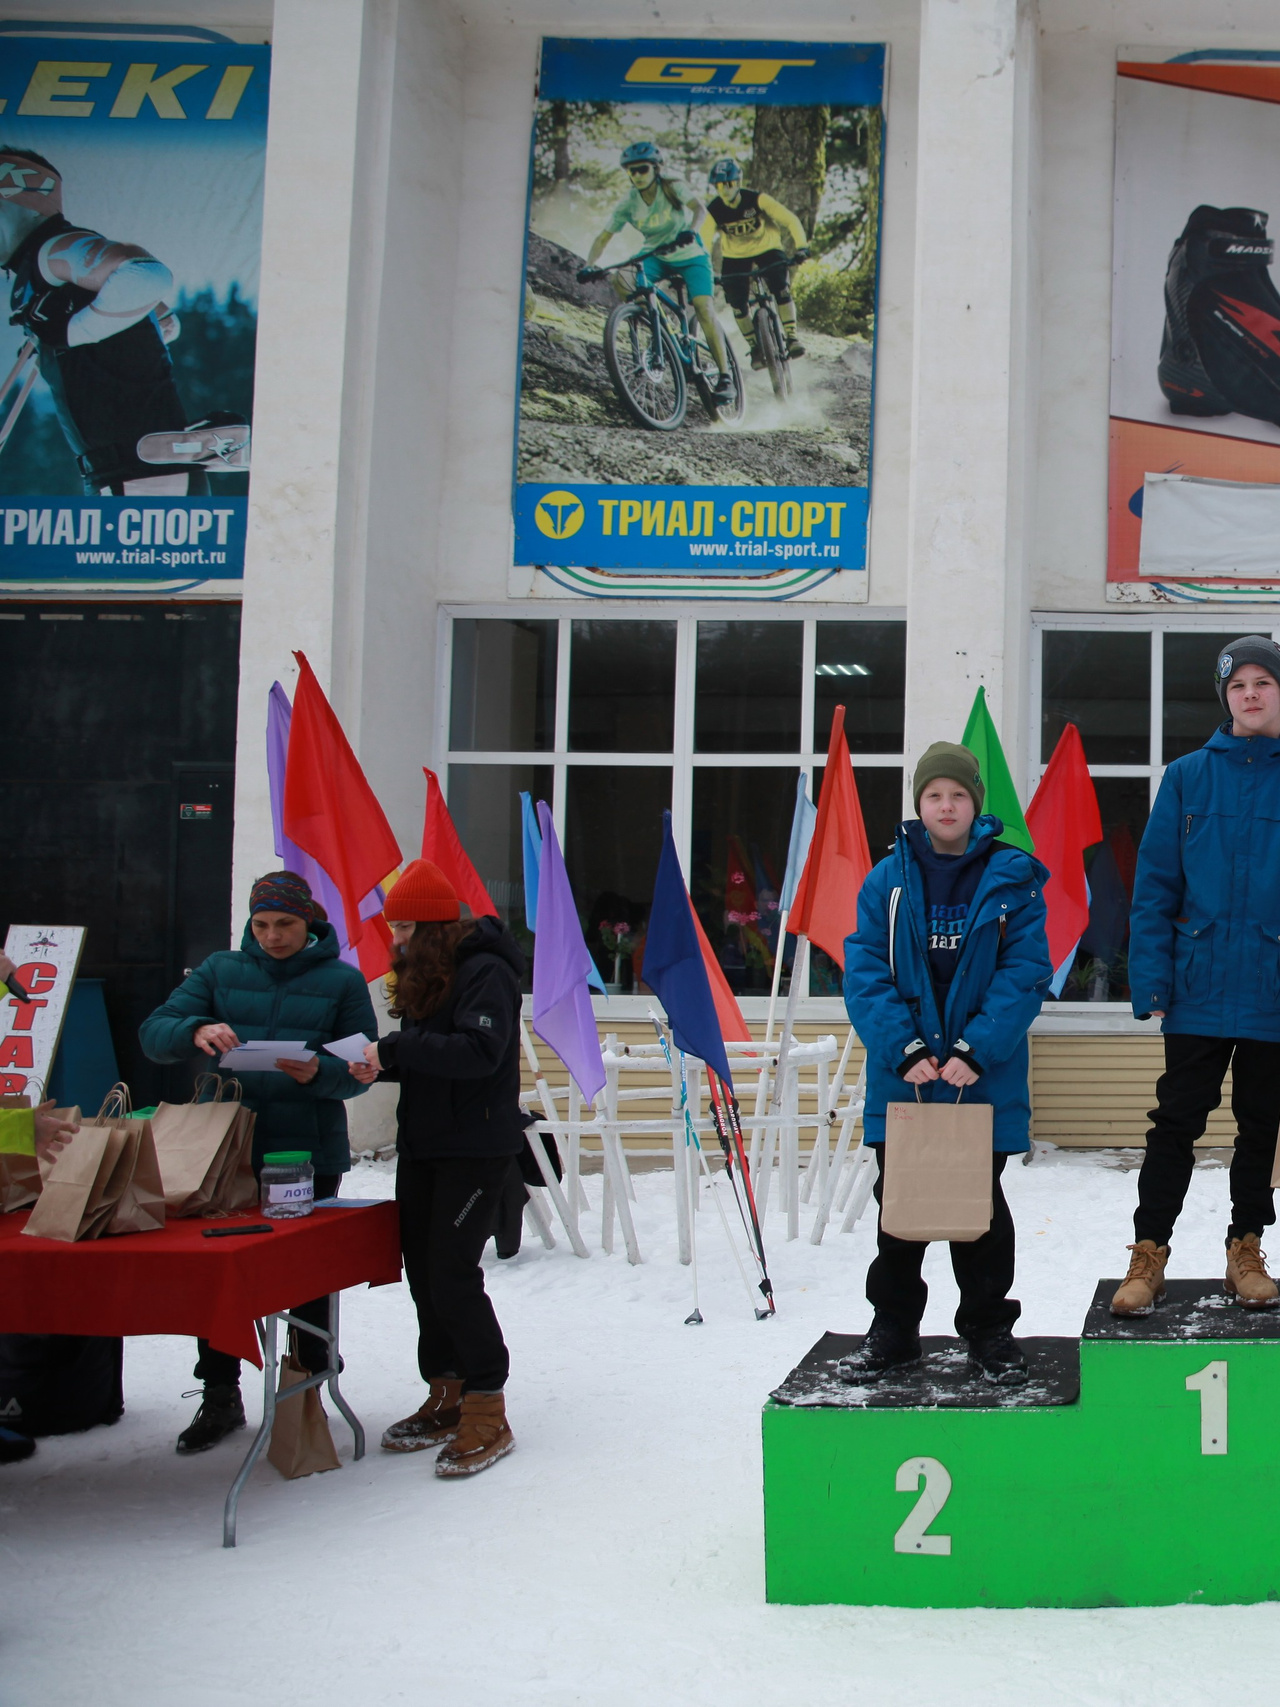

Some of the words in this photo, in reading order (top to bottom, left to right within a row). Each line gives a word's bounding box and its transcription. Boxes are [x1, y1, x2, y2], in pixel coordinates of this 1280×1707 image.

[625, 57, 816, 84] GT
[0, 60, 255, 120] EKI
[690, 86, 768, 95] BICYCLES
[76, 549, 226, 567] www.trial-sport.ru
[689, 541, 840, 560] www.trial-sport.ru
[717, 1105, 728, 1136] NORDWAY
[728, 1104, 740, 1135] NORDWAY
[454, 1188, 483, 1228] noname
[1186, 1360, 1228, 1455] 1
[894, 1456, 952, 1555] 2
